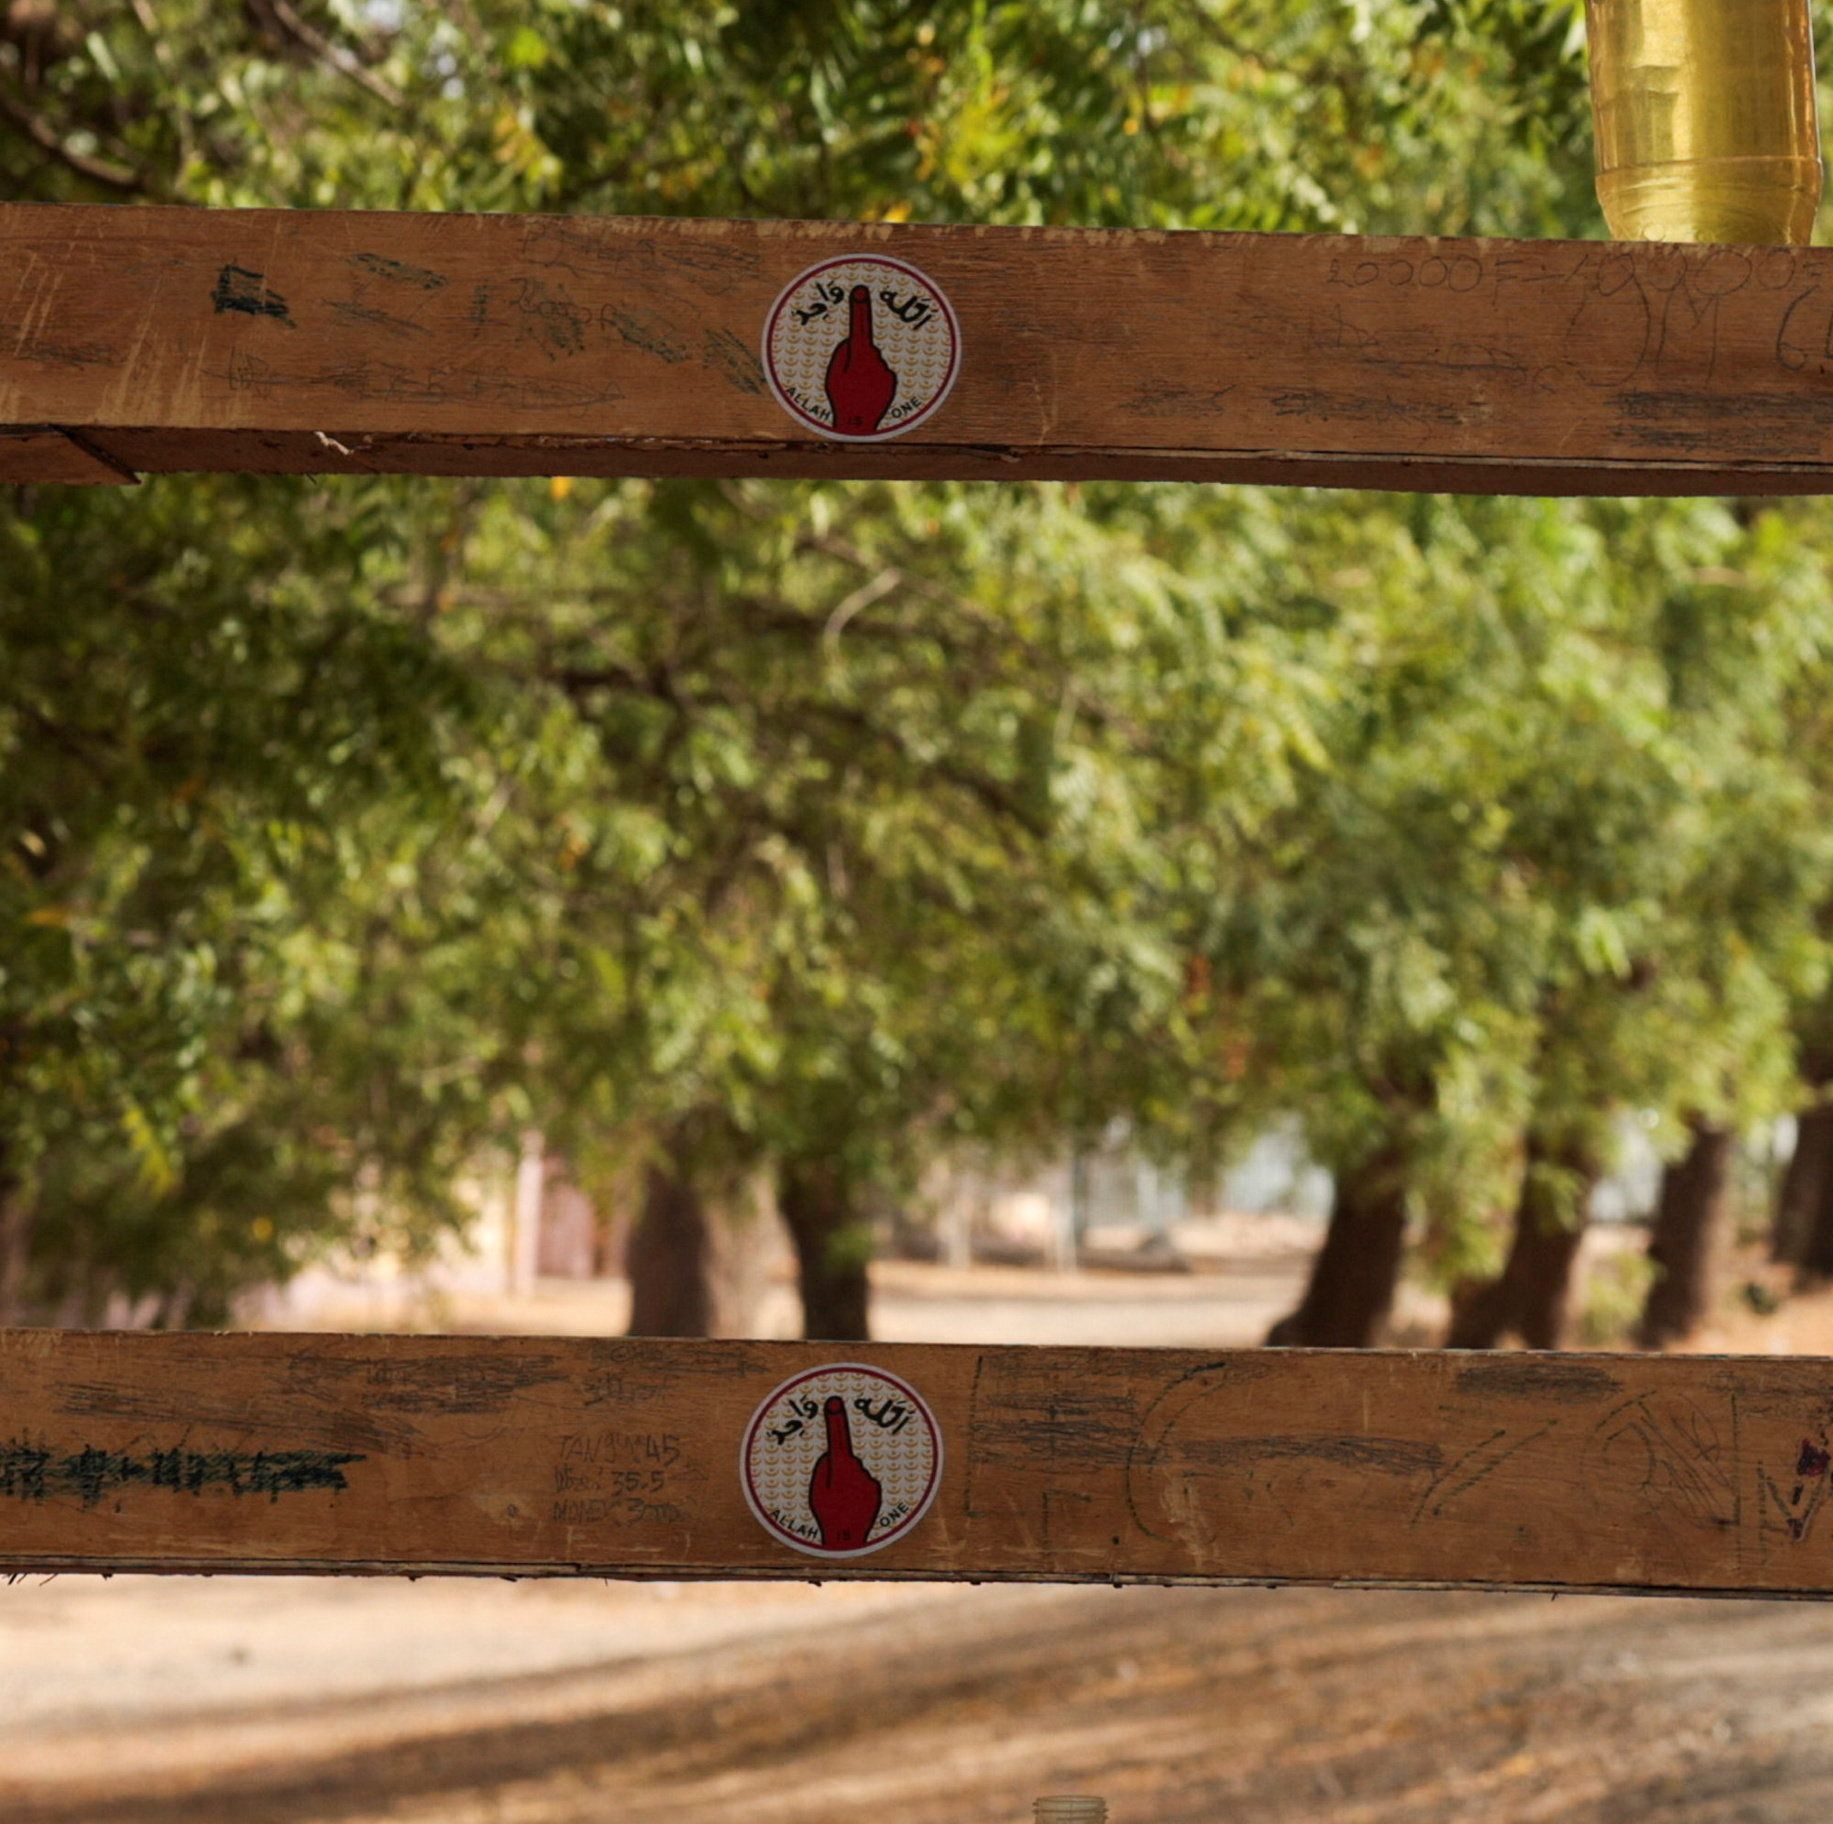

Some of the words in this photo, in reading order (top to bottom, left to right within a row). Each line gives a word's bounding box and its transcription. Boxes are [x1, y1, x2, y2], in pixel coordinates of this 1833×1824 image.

[785, 385, 832, 421] ALLAH
[890, 395, 923, 419] ONE
[769, 1508, 818, 1540] ALLAH
[878, 1501, 910, 1528] ONE
